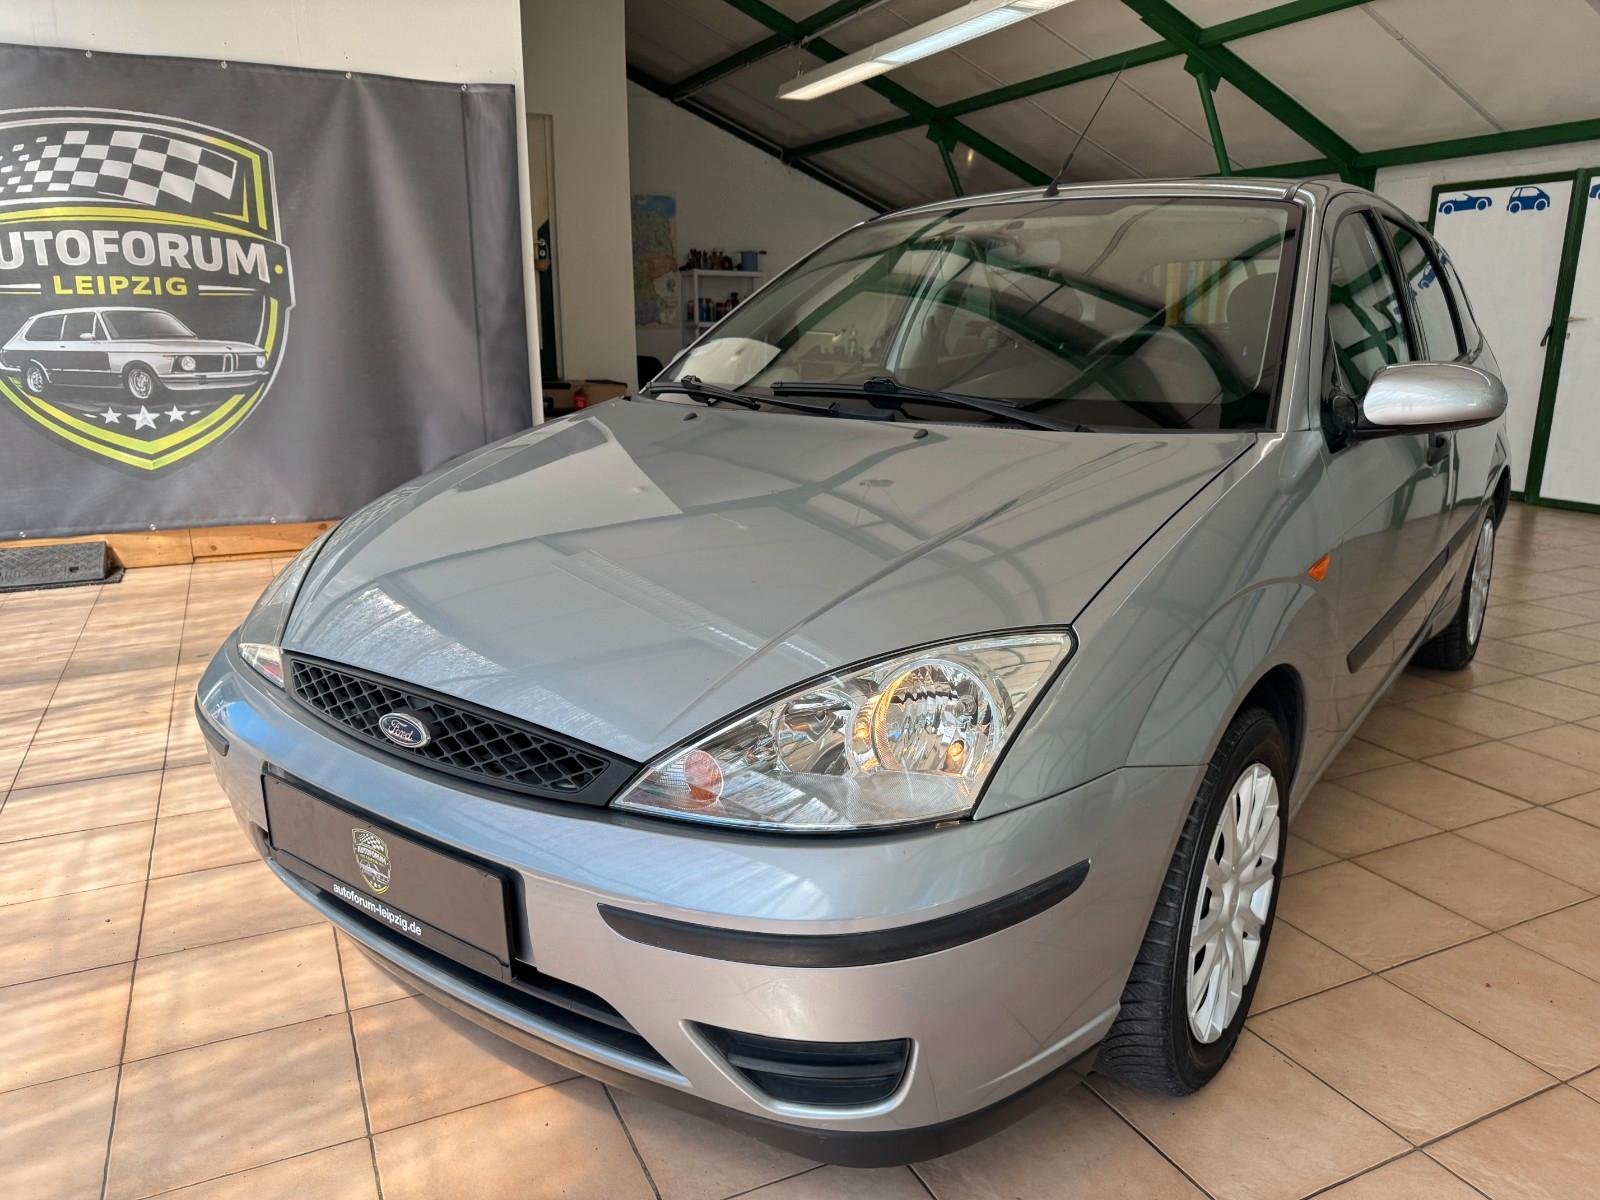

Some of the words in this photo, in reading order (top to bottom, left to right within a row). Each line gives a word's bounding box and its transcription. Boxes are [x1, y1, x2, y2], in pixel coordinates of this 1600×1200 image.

[0, 230, 271, 284] UTOFORUM
[53, 275, 188, 295] LEIPZIG
[387, 719, 413, 741] Ford
[333, 883, 422, 935] autoforum-leipzig.de
